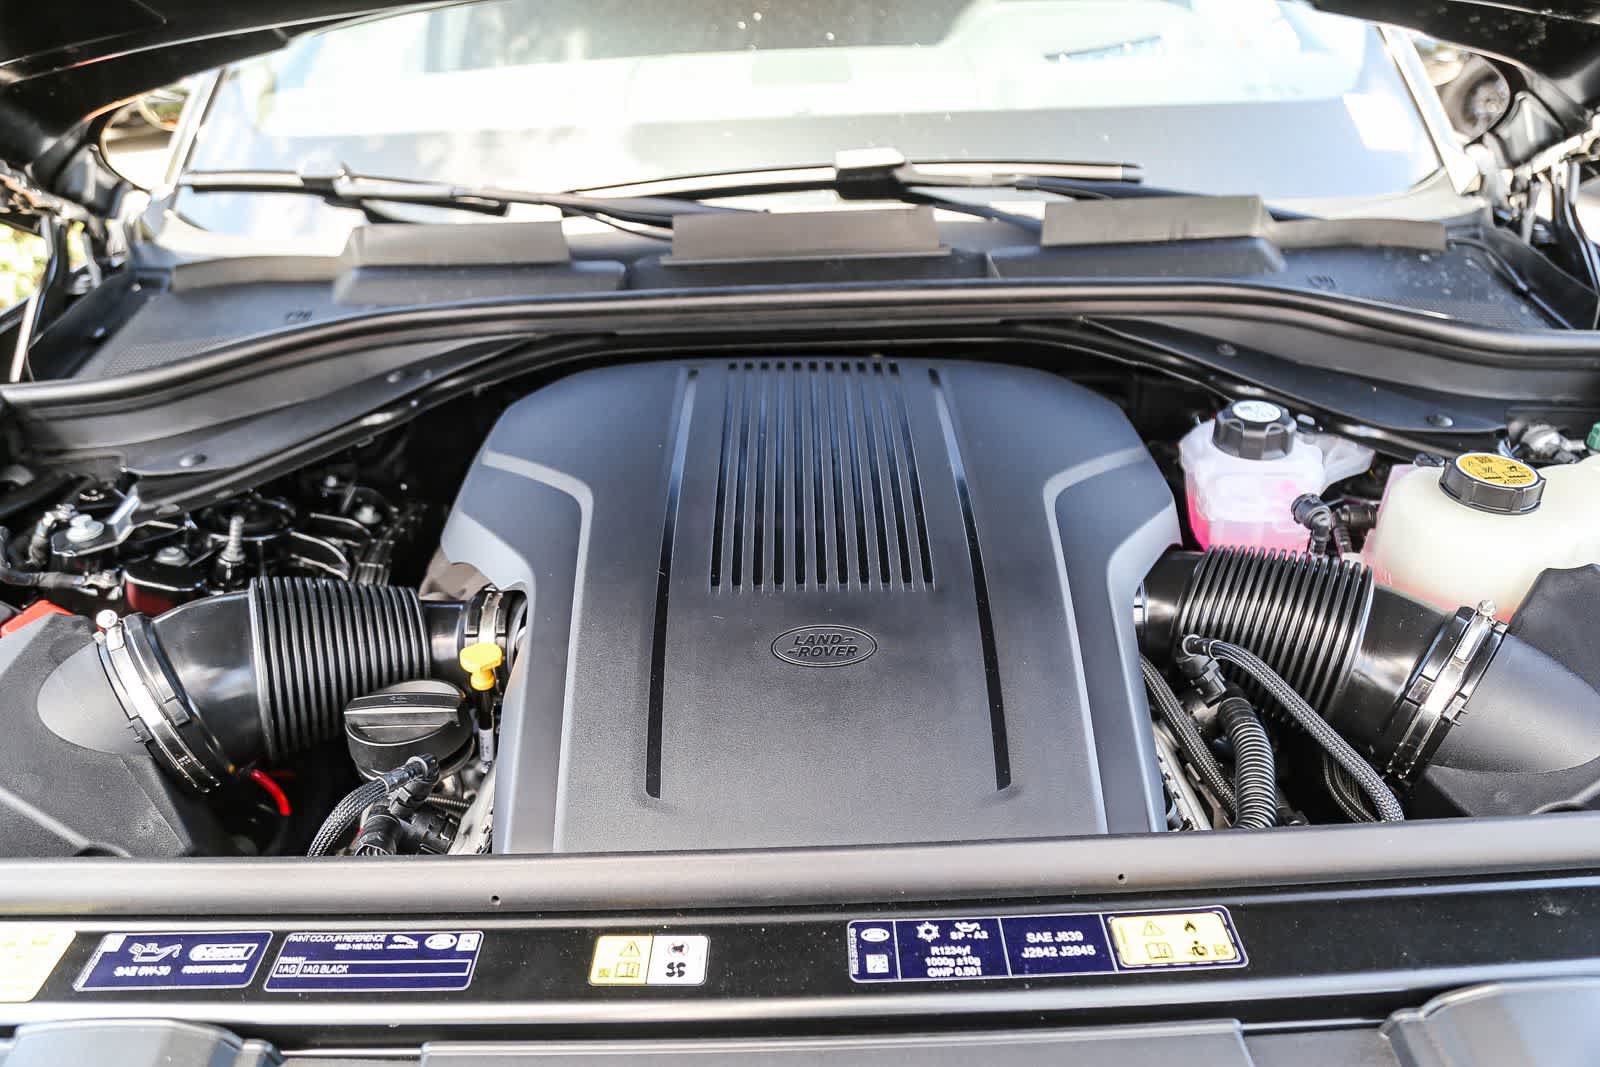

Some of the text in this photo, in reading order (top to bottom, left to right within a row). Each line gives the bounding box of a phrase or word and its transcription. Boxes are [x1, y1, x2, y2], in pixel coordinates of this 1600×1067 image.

[794, 634, 842, 646] LAND
[797, 645, 859, 658] ROVER
[288, 934, 387, 942] PAINT COLOUR REFERENCE
[1026, 932, 1053, 943] SAE
[319, 964, 349, 973] BLACK
